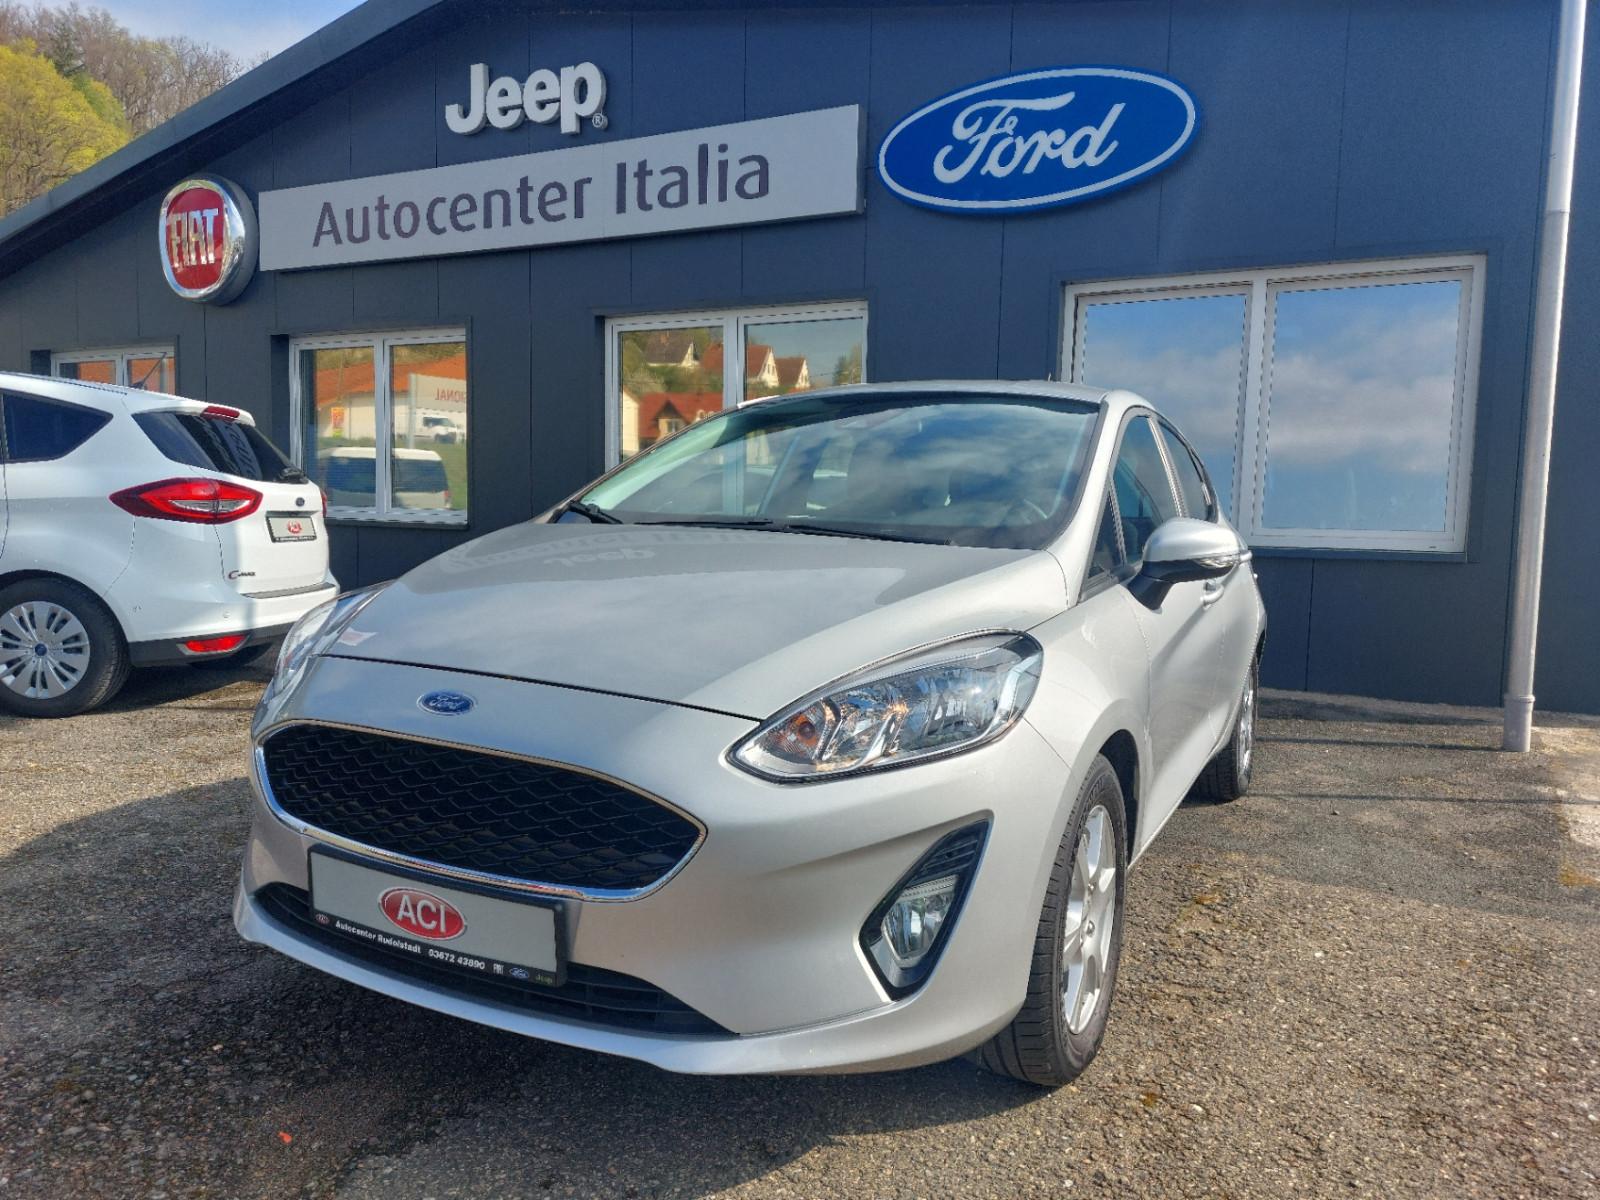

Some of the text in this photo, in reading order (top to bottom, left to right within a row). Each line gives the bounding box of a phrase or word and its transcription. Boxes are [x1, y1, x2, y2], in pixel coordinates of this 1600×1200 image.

[445, 62, 606, 136] Jeep
[933, 91, 1126, 184] Ford
[312, 143, 770, 248] Autocenter Italia
[170, 208, 219, 268] FIAT
[428, 695, 465, 710] Ford
[396, 894, 447, 934] ACI
[335, 920, 376, 940] Autocenter
[377, 934, 422, 954] Rudolstadt
[428, 948, 455, 963] 03672
[457, 956, 486, 970] 43890
